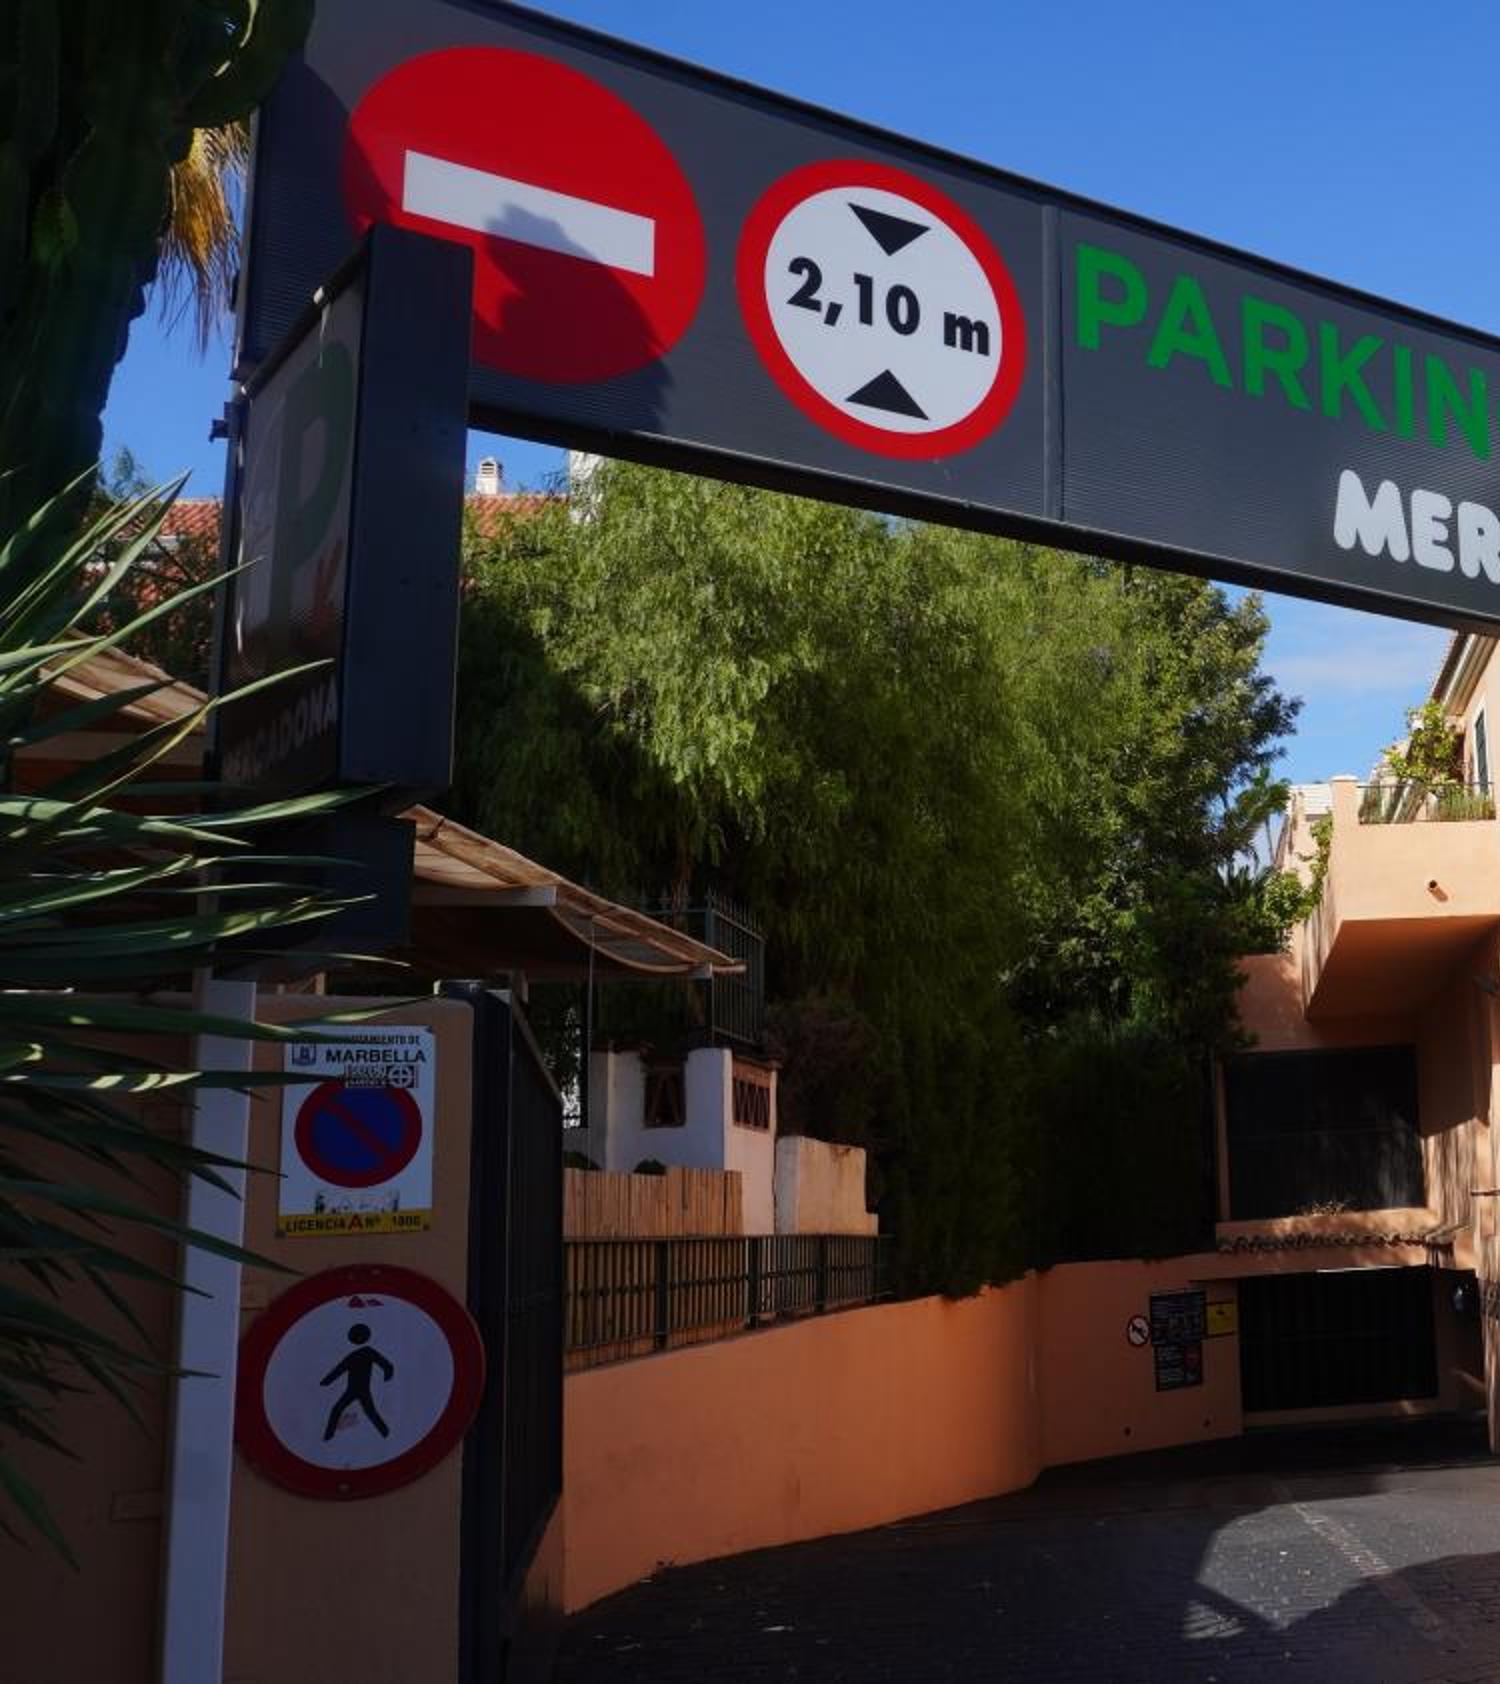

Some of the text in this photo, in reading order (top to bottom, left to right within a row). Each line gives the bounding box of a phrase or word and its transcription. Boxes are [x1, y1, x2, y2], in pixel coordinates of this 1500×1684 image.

[786, 256, 991, 357] 2,10 m
[325, 1049, 427, 1064] MARBELLA
